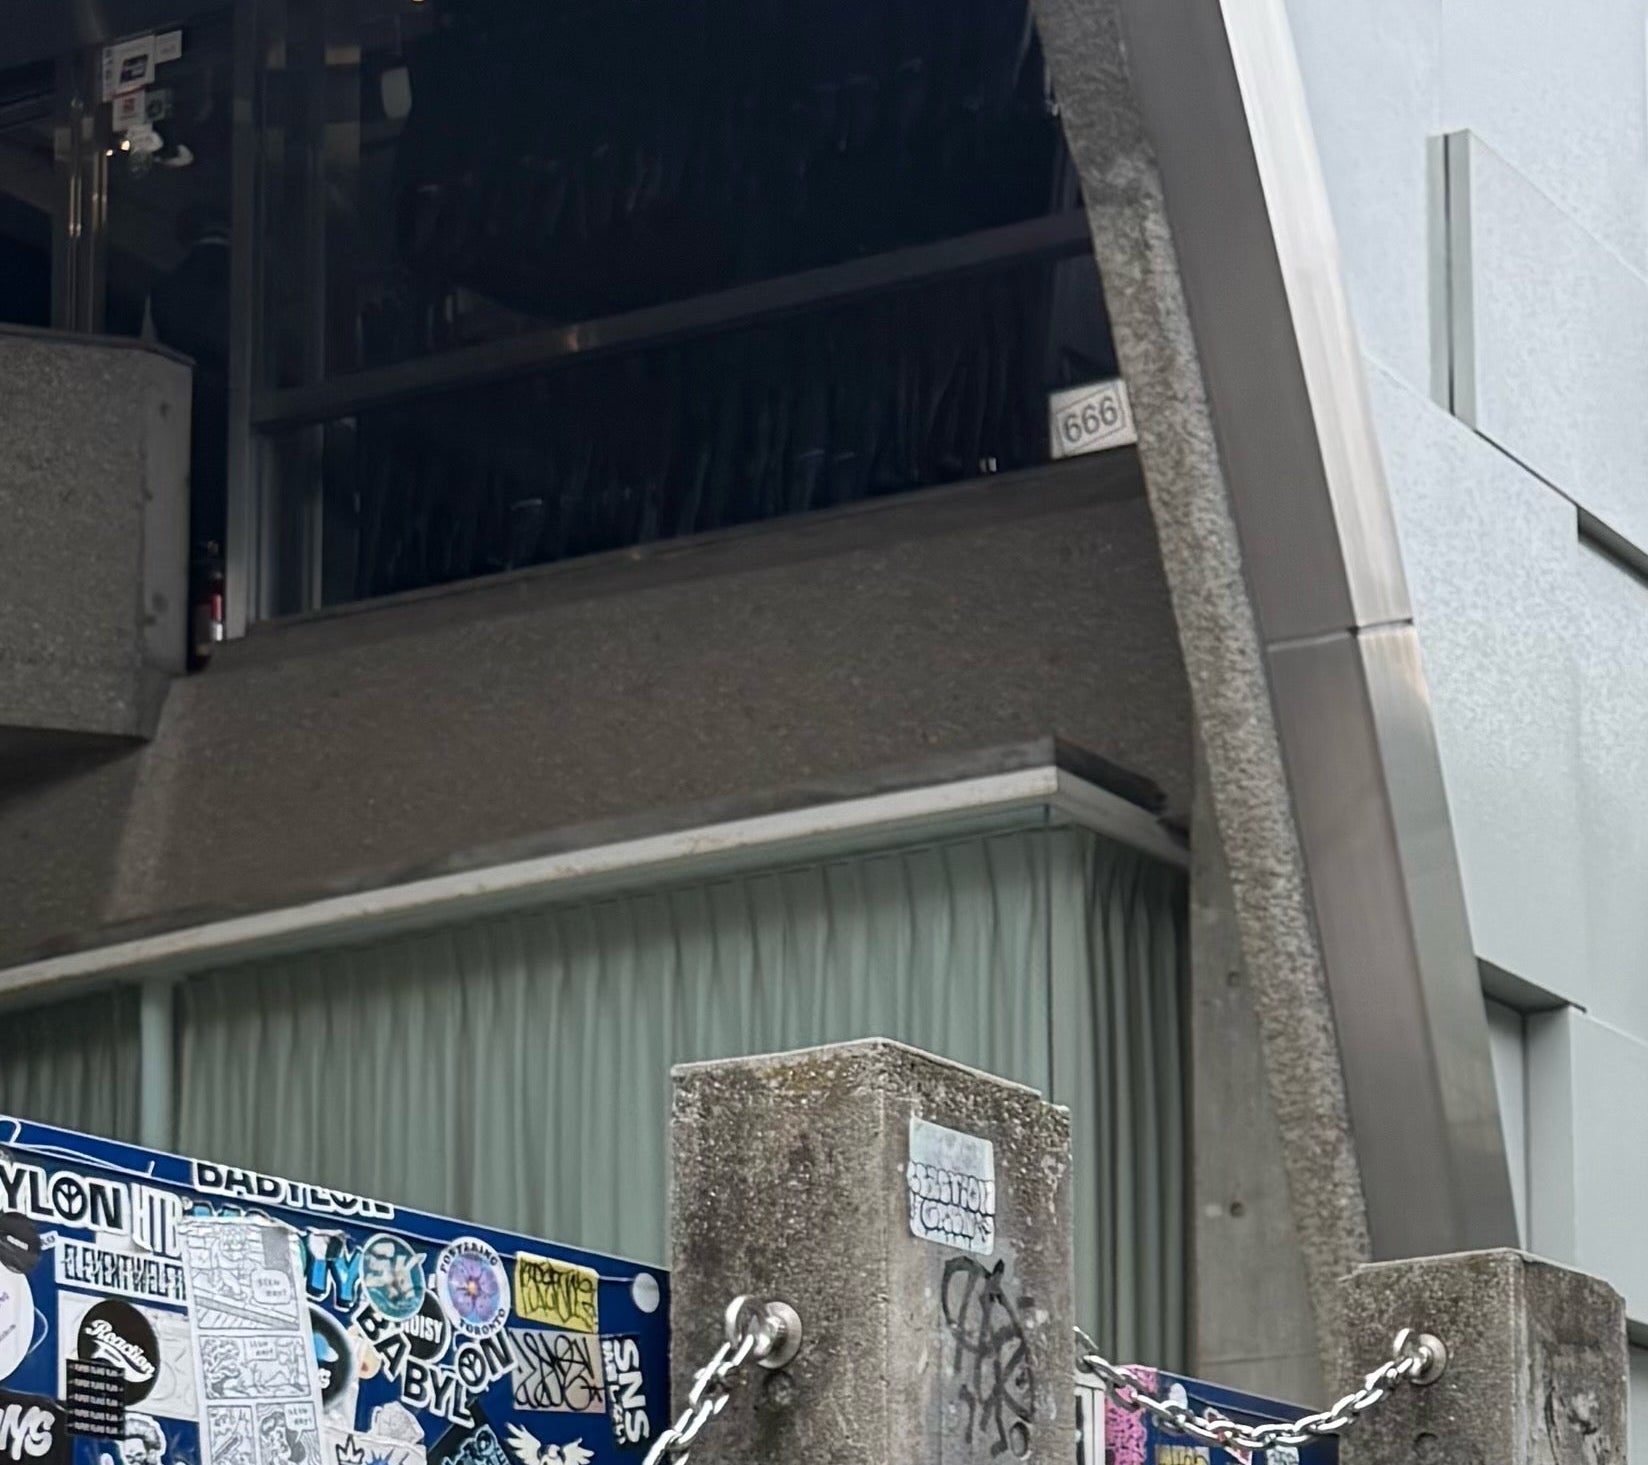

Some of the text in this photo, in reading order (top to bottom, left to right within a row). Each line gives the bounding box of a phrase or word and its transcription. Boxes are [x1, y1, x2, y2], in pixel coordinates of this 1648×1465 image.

[1064, 396, 1118, 442] 666
[85, 1319, 156, 1374] Reaction
[460, 1308, 505, 1335] TORONTO
[614, 1338, 650, 1443] SNS
